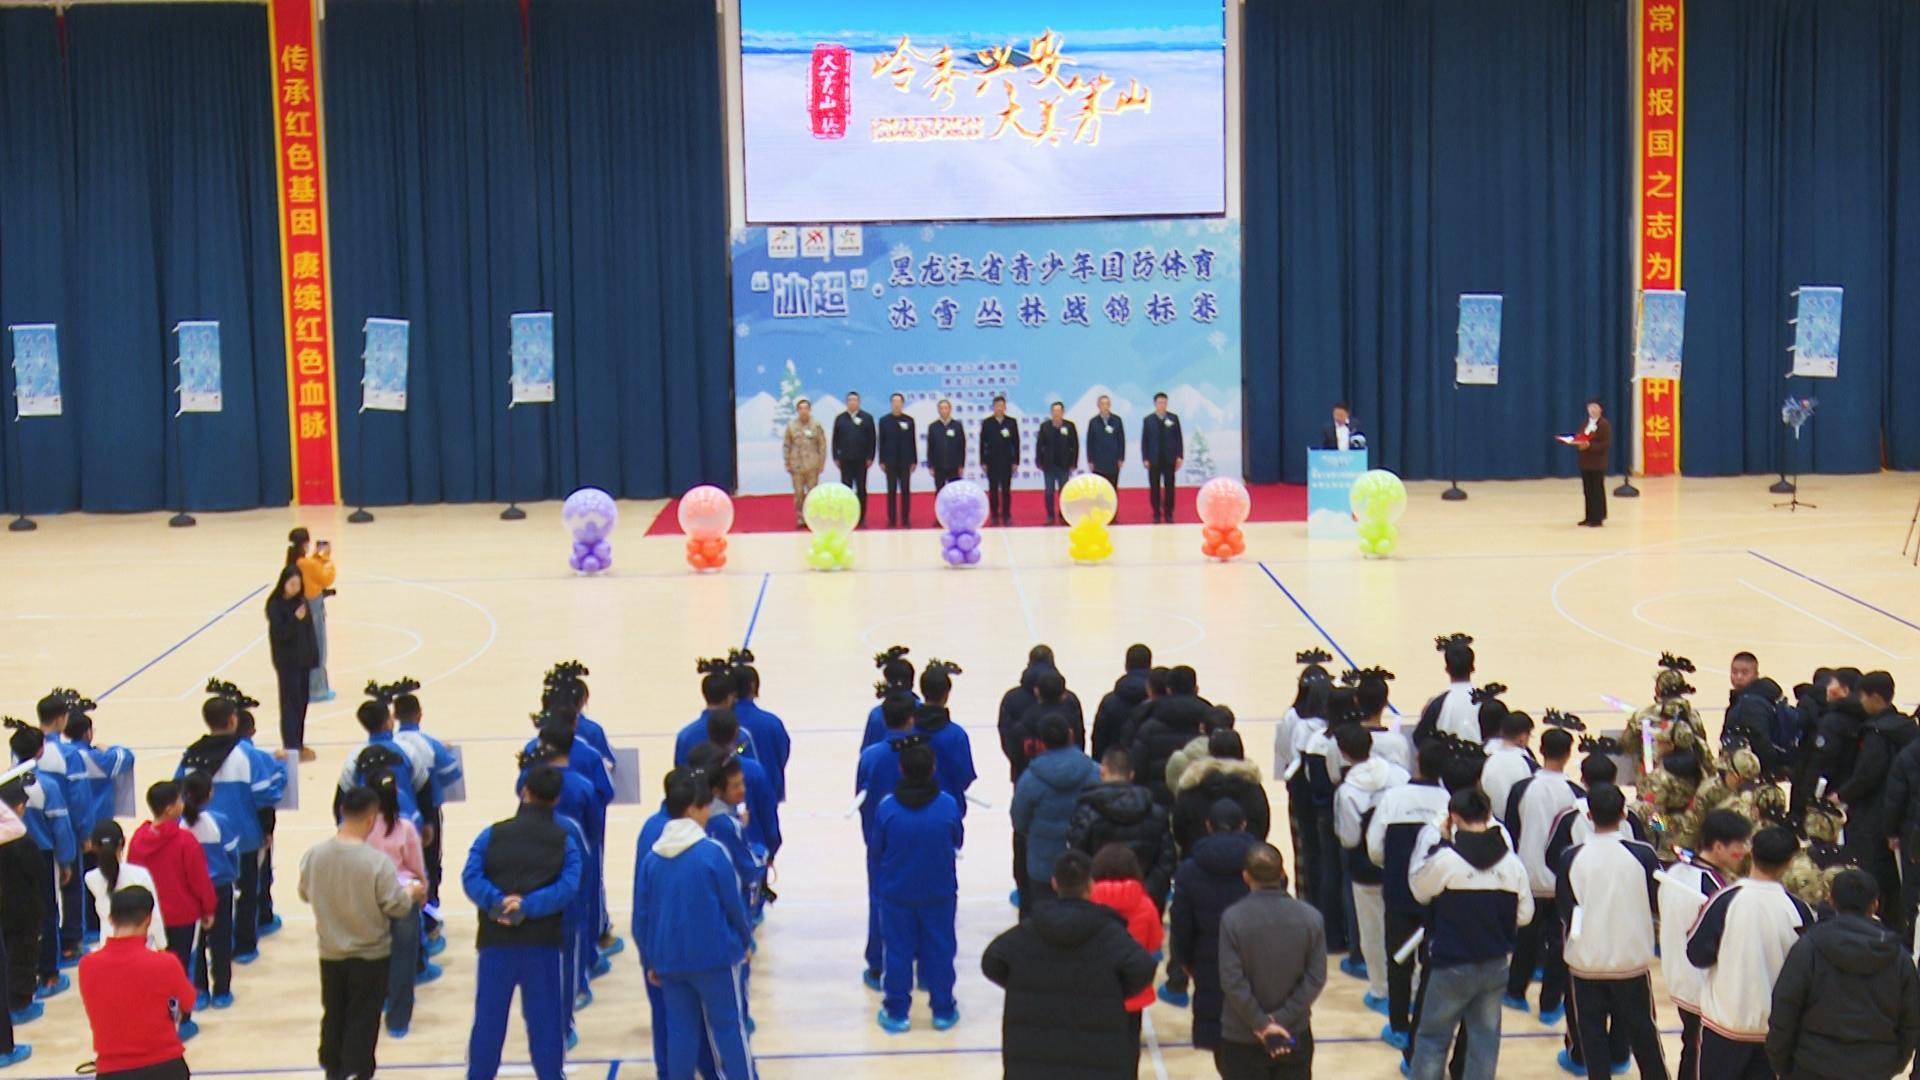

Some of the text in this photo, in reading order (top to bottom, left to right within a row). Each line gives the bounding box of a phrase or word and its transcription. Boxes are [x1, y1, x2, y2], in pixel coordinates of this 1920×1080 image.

[281, 43, 317, 237] 传承红色基因
[890, 249, 1216, 286] 黑龙江省青少年国防体育
[890, 292, 1218, 329] 冰雪丛林战锦标赛
[292, 250, 328, 440] 赓续红色血脉
